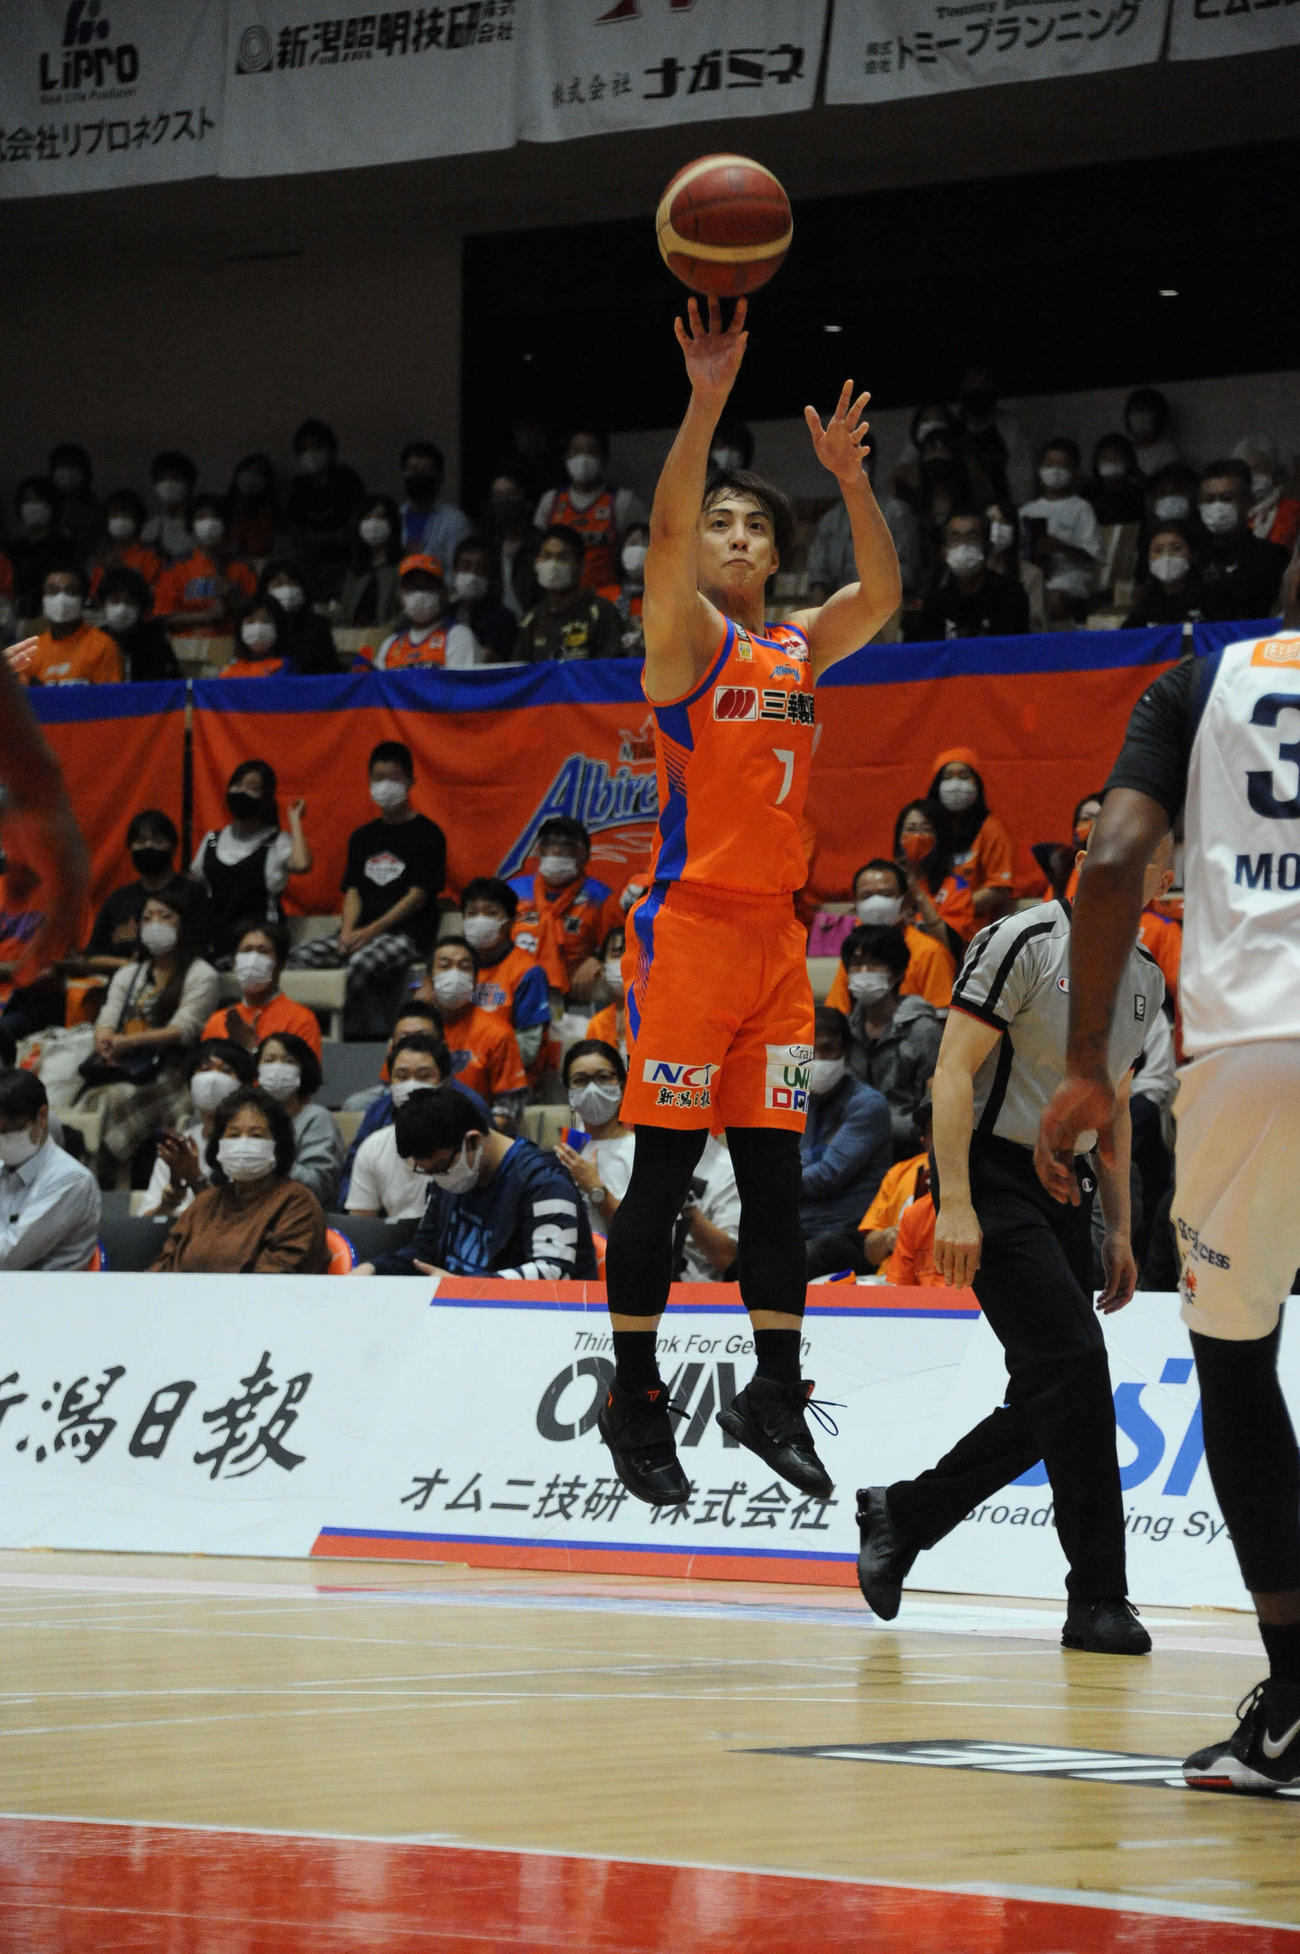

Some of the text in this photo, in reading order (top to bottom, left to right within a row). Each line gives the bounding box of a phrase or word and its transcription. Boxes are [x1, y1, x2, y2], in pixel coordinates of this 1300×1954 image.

[897, 1, 1143, 70] トミープランニング
[643, 43, 806, 99] ナガミネ
[496, 752, 658, 881] Albire
[574, 1332, 614, 1351] Thin
[685, 1335, 722, 1354] For
[0, 1350, 313, 1480] 潟日報
[400, 1468, 629, 1523] オムニ技研
